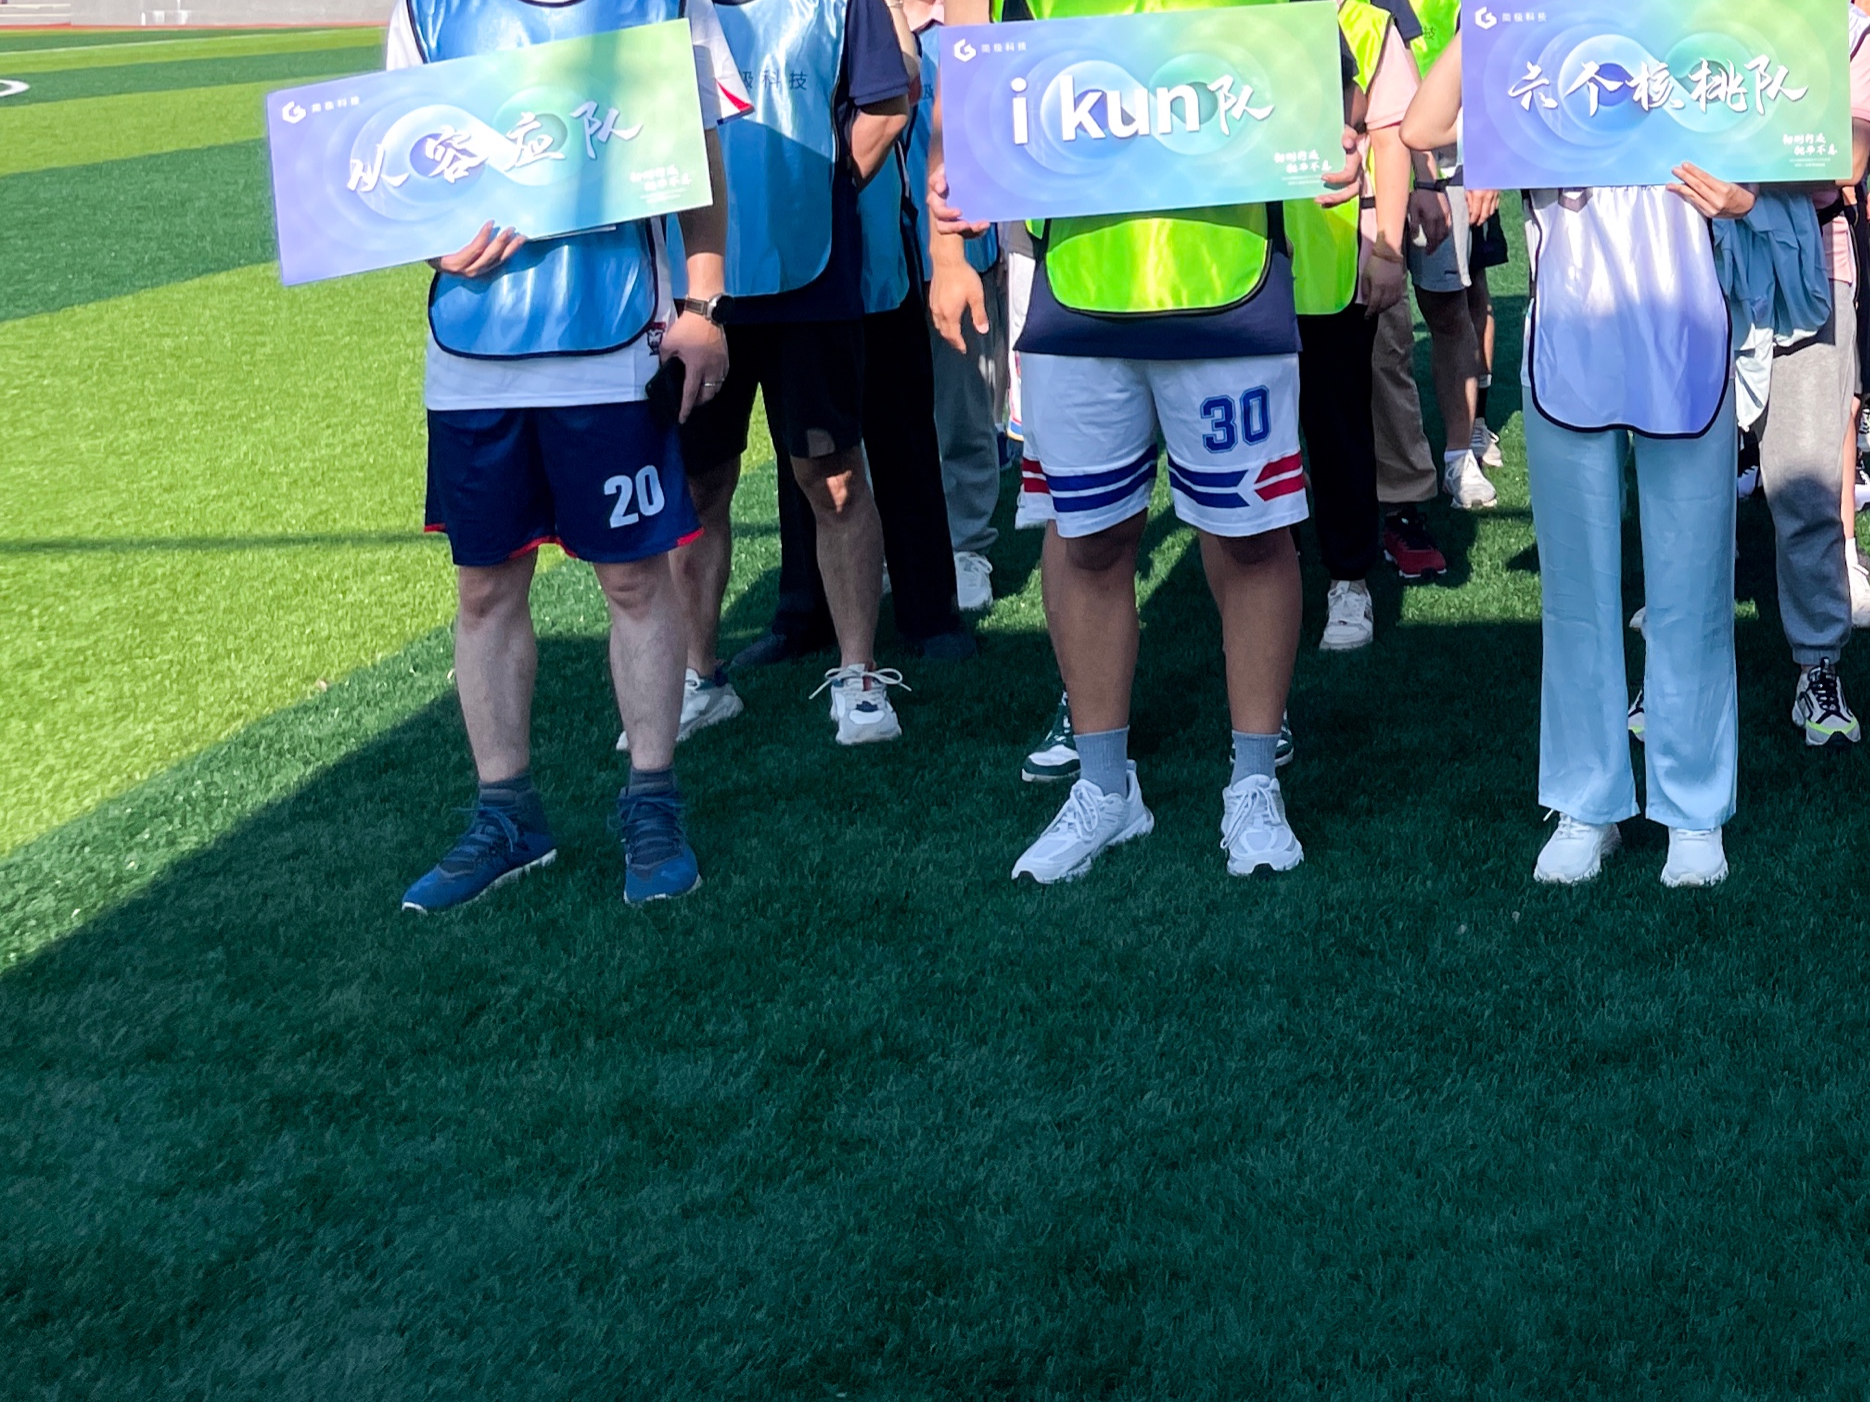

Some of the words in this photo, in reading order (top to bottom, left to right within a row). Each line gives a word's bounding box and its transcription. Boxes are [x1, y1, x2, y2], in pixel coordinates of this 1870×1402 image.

[1508, 54, 1808, 117] 六个核桃队
[346, 100, 643, 192] 从容应队
[1200, 384, 1271, 454] 30
[604, 464, 665, 529] 20
